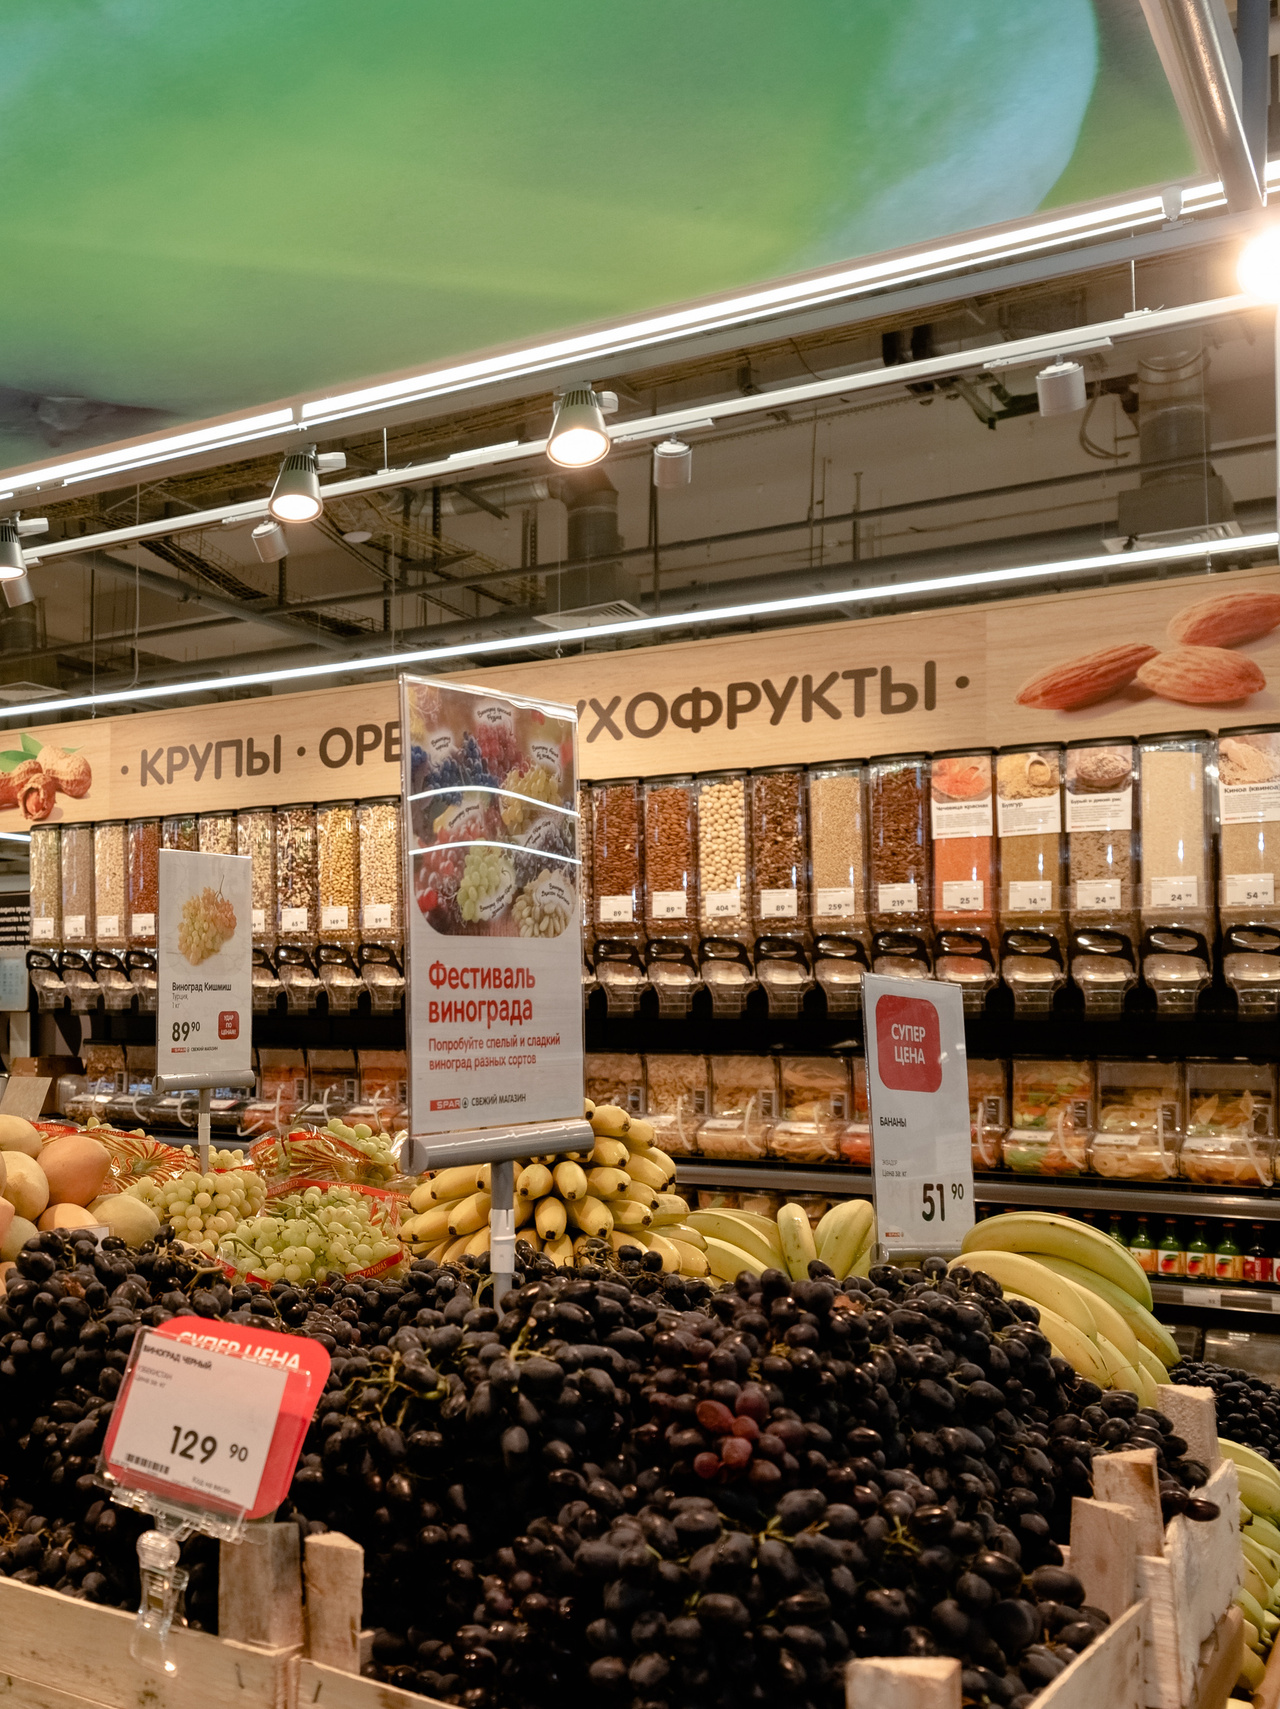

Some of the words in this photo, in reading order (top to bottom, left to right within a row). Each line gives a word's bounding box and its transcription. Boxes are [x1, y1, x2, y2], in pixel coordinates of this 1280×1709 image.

[577, 660, 937, 743] ХОФРУКТЫ
[141, 734, 282, 787] КРУПЫ
[319, 721, 402, 769] ОРЕ
[1002, 801, 1023, 809] Булгур
[428, 960, 536, 990] Фестиваль
[172, 982, 203, 993] Виноград
[204, 982, 232, 991] Кишмиш
[428, 999, 533, 1029] винограда
[172, 1022, 190, 1042] 89
[191, 1021, 200, 1032] 90
[891, 1023, 926, 1043] СУПЕР
[428, 1035, 483, 1054] Попробуйте
[486, 1034, 517, 1051] спелый
[520, 1036, 525, 1046] и
[527, 1033, 560, 1049] сладкий
[429, 1059, 472, 1072] виноград
[474, 1056, 506, 1071] разных
[508, 1053, 536, 1069] сортов
[894, 1046, 926, 1065] ЦЕНА
[436, 1100, 460, 1109] SPAR
[471, 1093, 497, 1106] СВЕЖИЙ
[499, 1093, 526, 1104] МАГАЗИН
[880, 1117, 906, 1127] БАНАНЫ
[882, 1170, 894, 1178] Цена
[922, 1183, 945, 1222] 51
[951, 1183, 964, 1200] 90
[142, 1345, 181, 1362] ВИНОГРАД
[182, 1355, 212, 1370] ЧЕРНЫЙ
[170, 1425, 218, 1465] 129
[229, 1443, 248, 1462] 90
